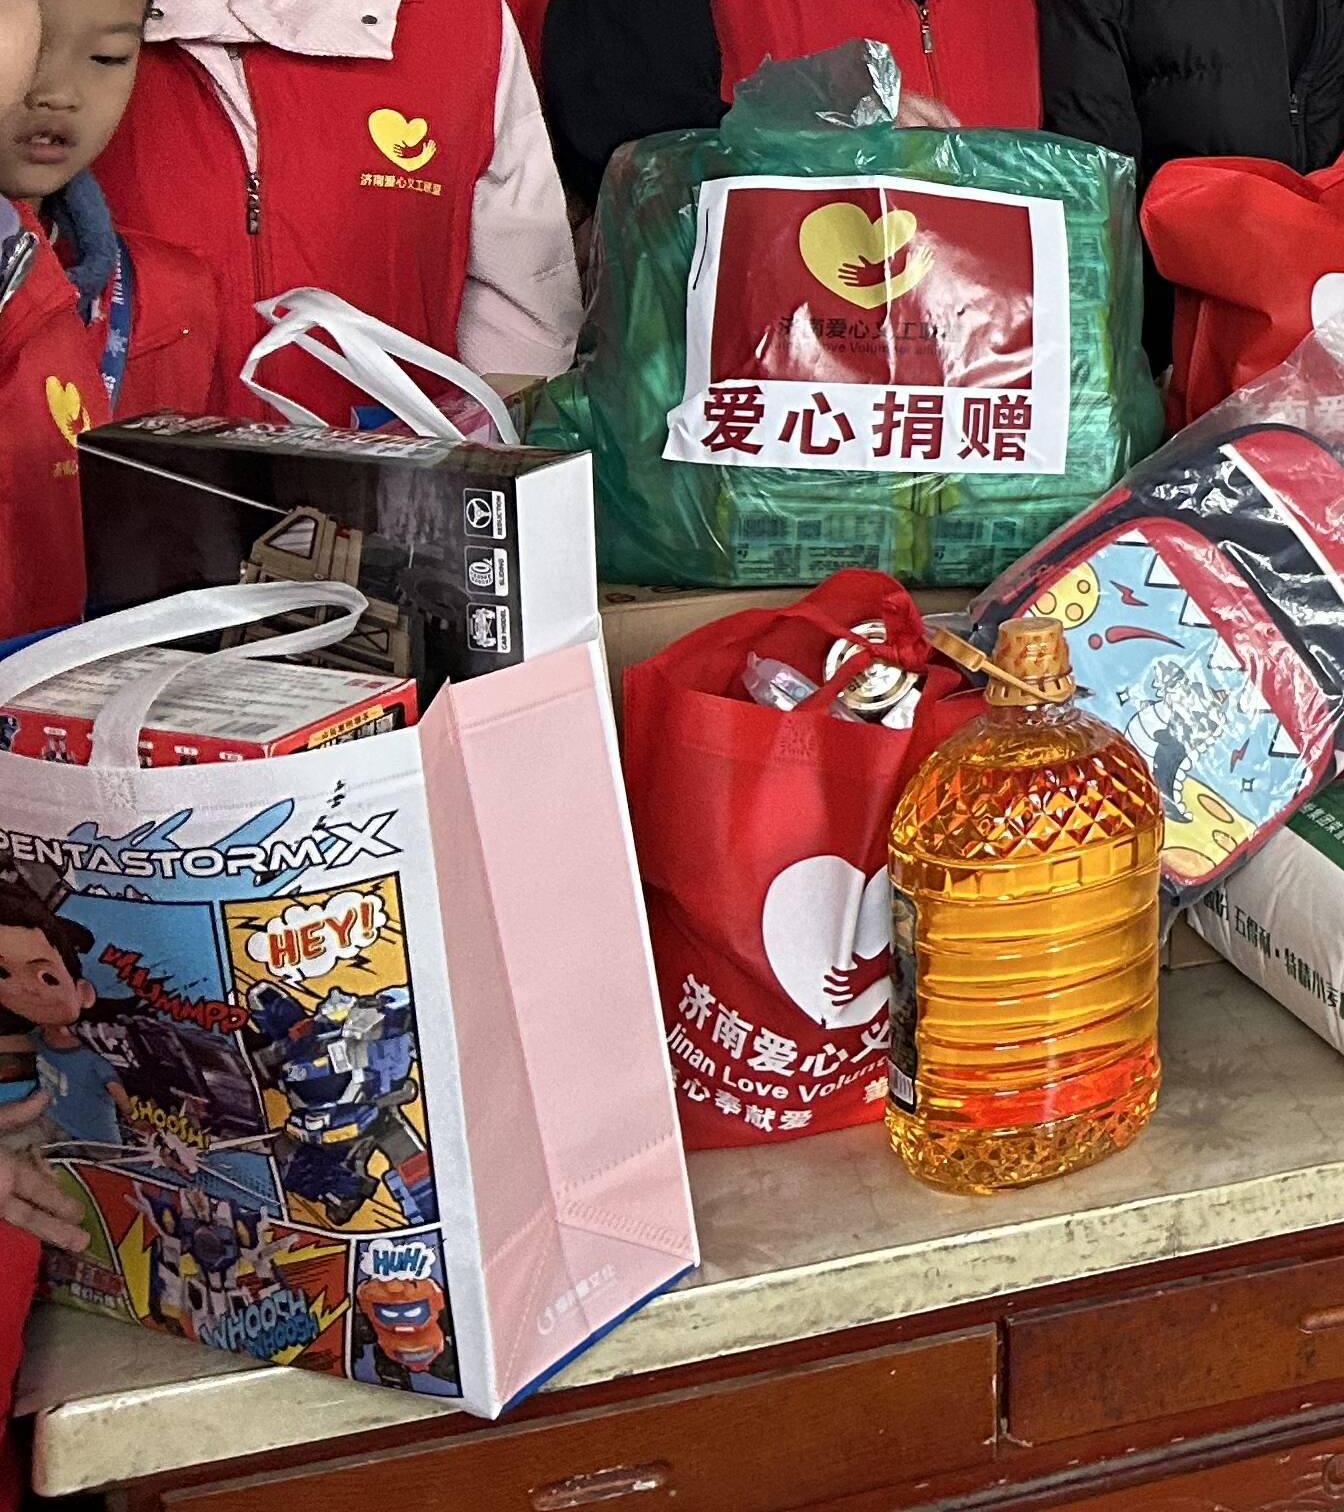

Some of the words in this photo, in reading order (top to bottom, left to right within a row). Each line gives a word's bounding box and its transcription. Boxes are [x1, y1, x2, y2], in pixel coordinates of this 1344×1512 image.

[702, 384, 1032, 462] 爱心捐赠
[268, 902, 376, 969] HEY!
[667, 1023, 716, 1077] Jinan
[722, 1065, 789, 1100] Love
[372, 1248, 426, 1277] HUH!
